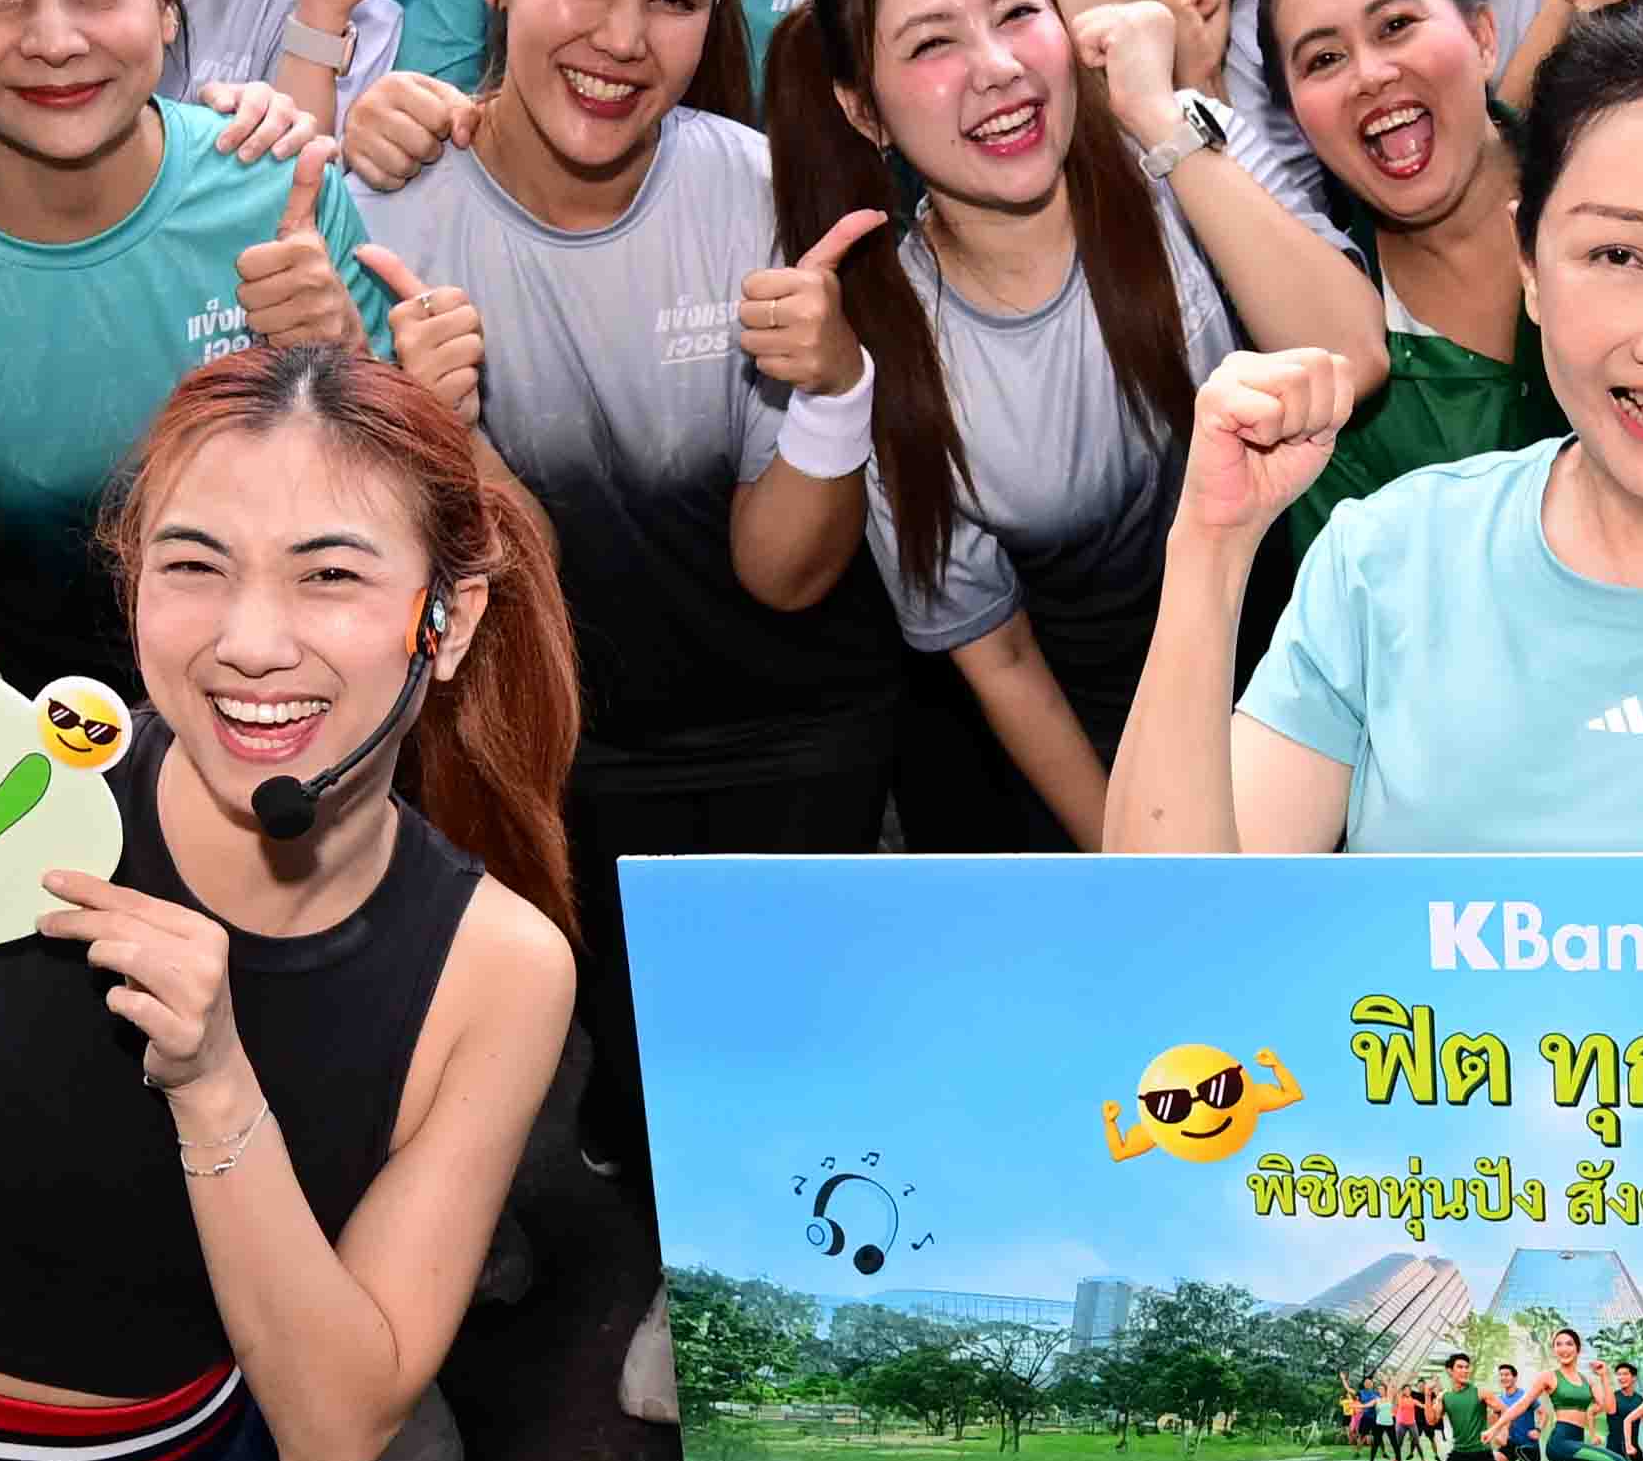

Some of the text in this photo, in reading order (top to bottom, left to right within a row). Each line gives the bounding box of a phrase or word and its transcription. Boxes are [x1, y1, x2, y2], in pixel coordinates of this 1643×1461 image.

[1349, 992, 1511, 1110] ฟิต
[1245, 1151, 1547, 1242] พิชิตหุ่นปัง
